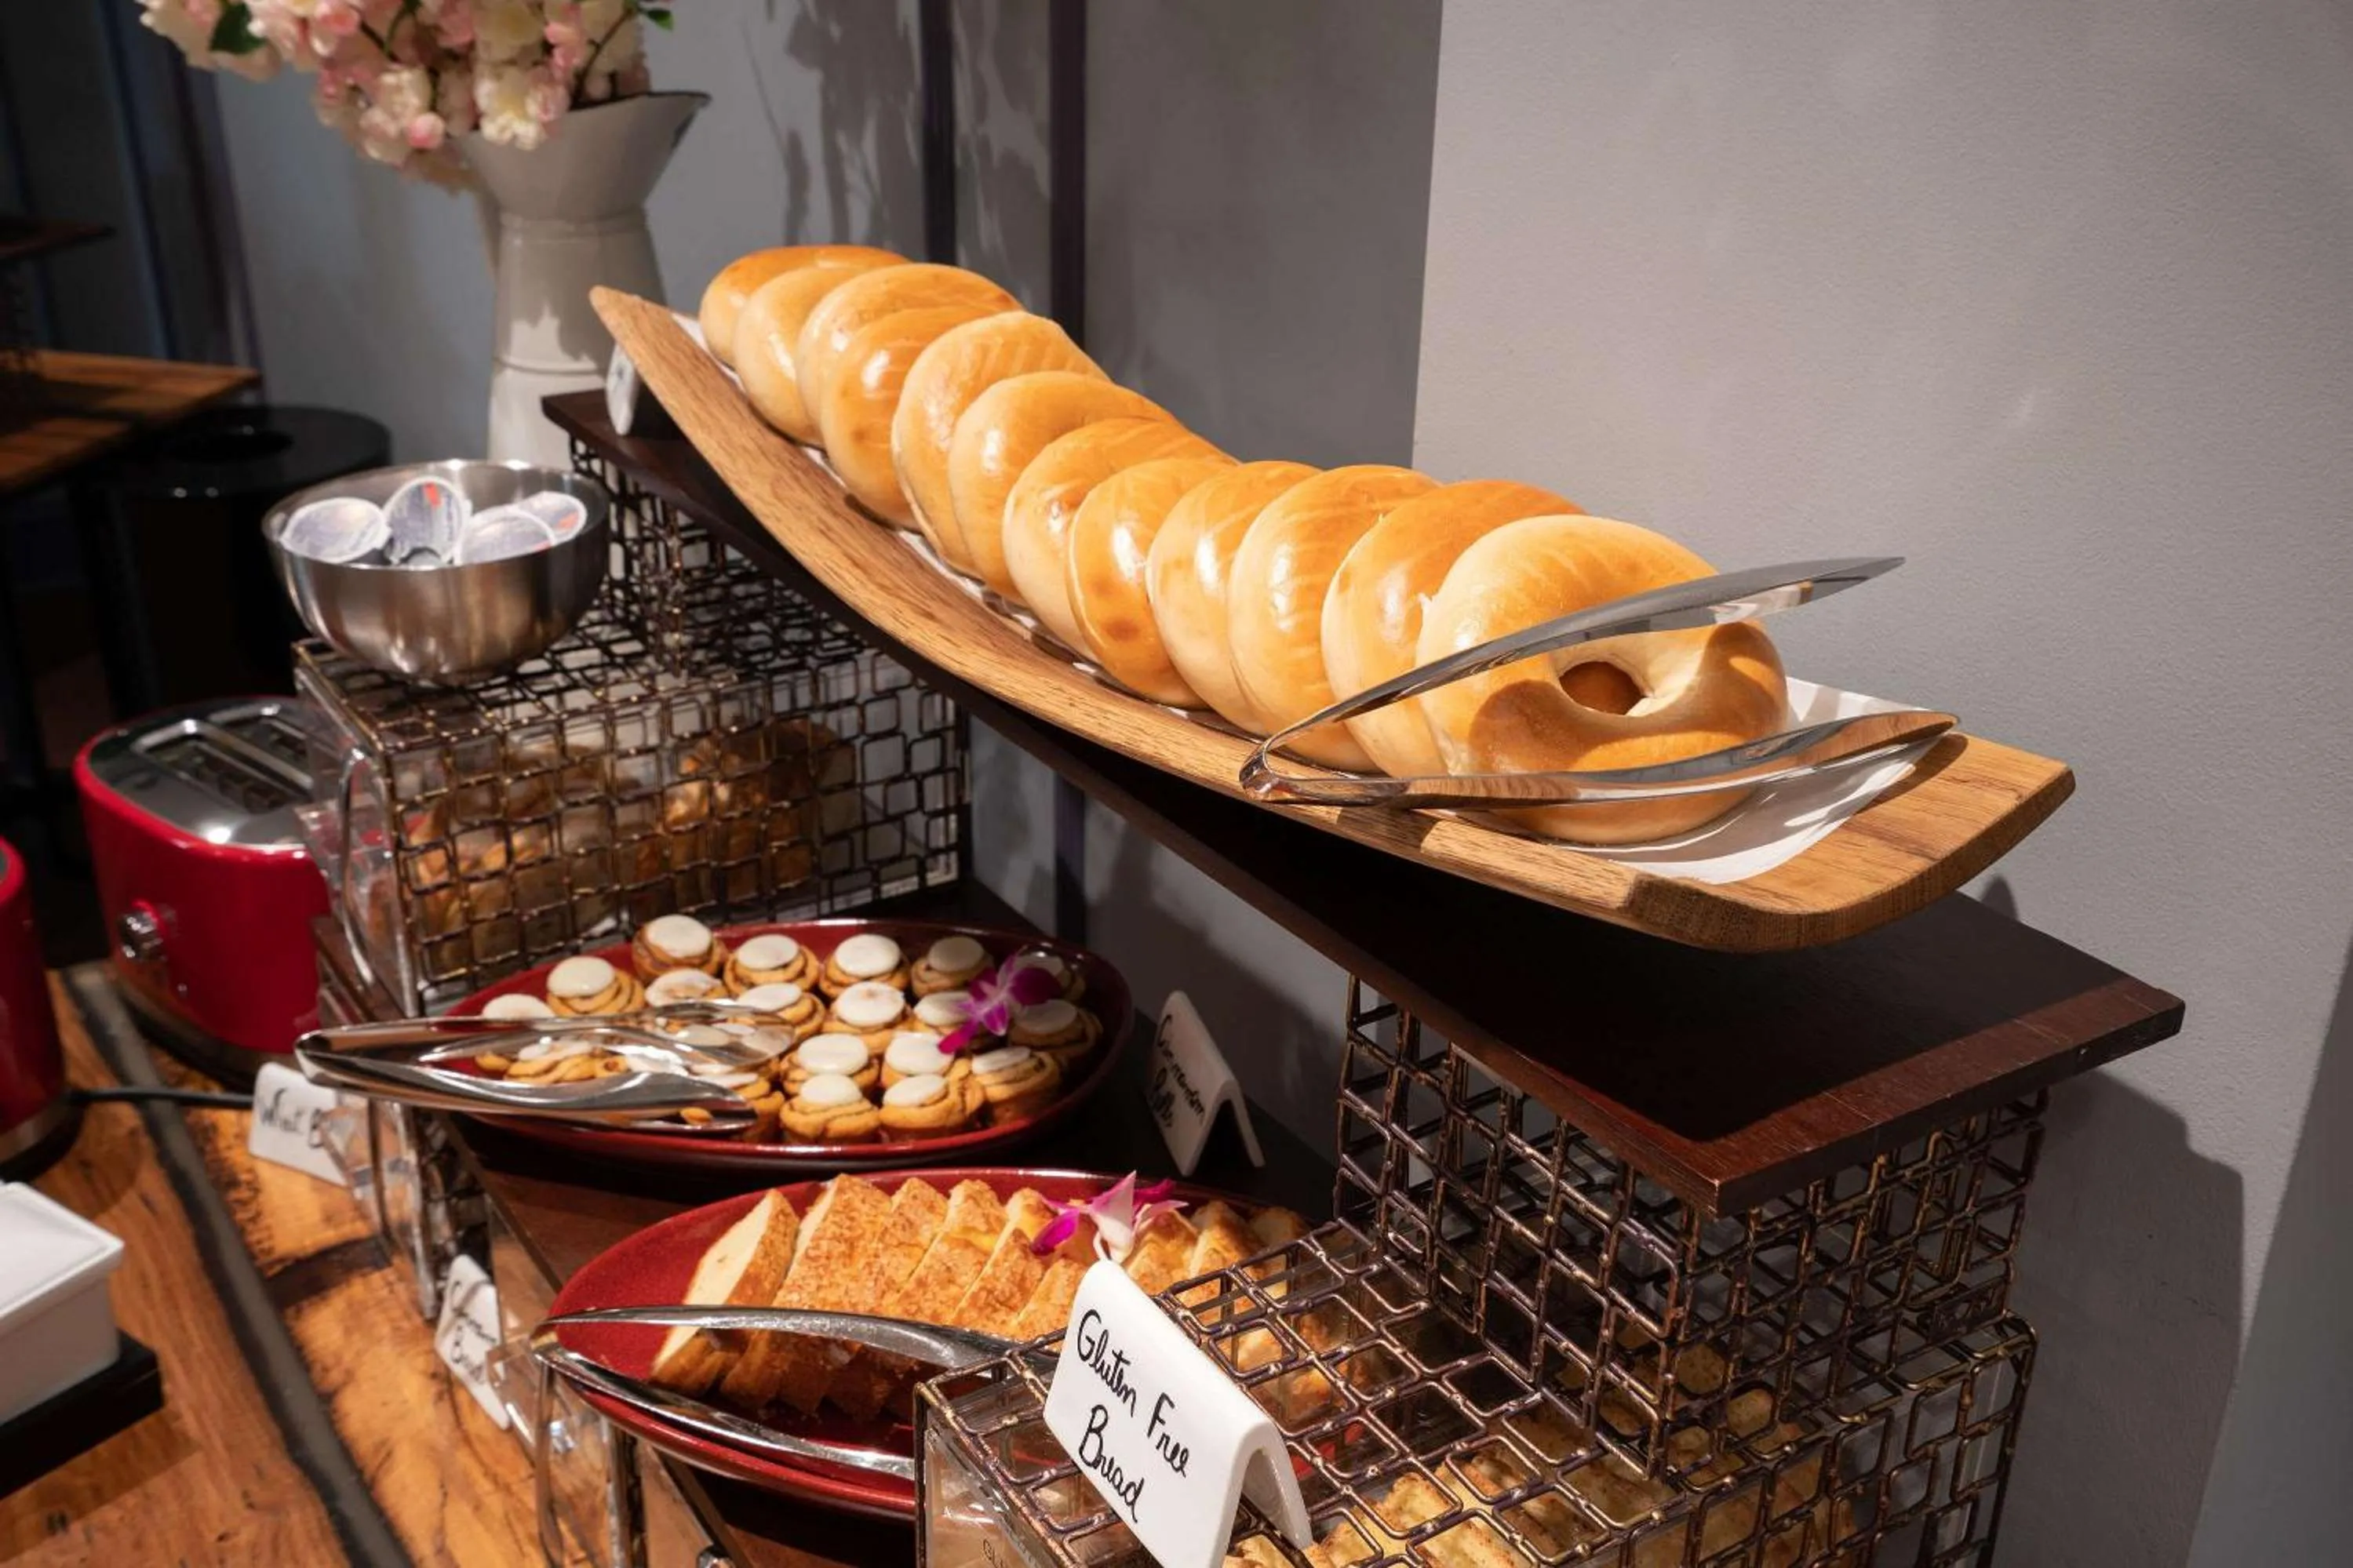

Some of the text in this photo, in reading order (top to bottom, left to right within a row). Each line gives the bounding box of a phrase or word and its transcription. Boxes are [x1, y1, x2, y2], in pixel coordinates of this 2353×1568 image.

[1077, 1308, 1190, 1478] Gluten Free
[1078, 1404, 1146, 1523] Bread
